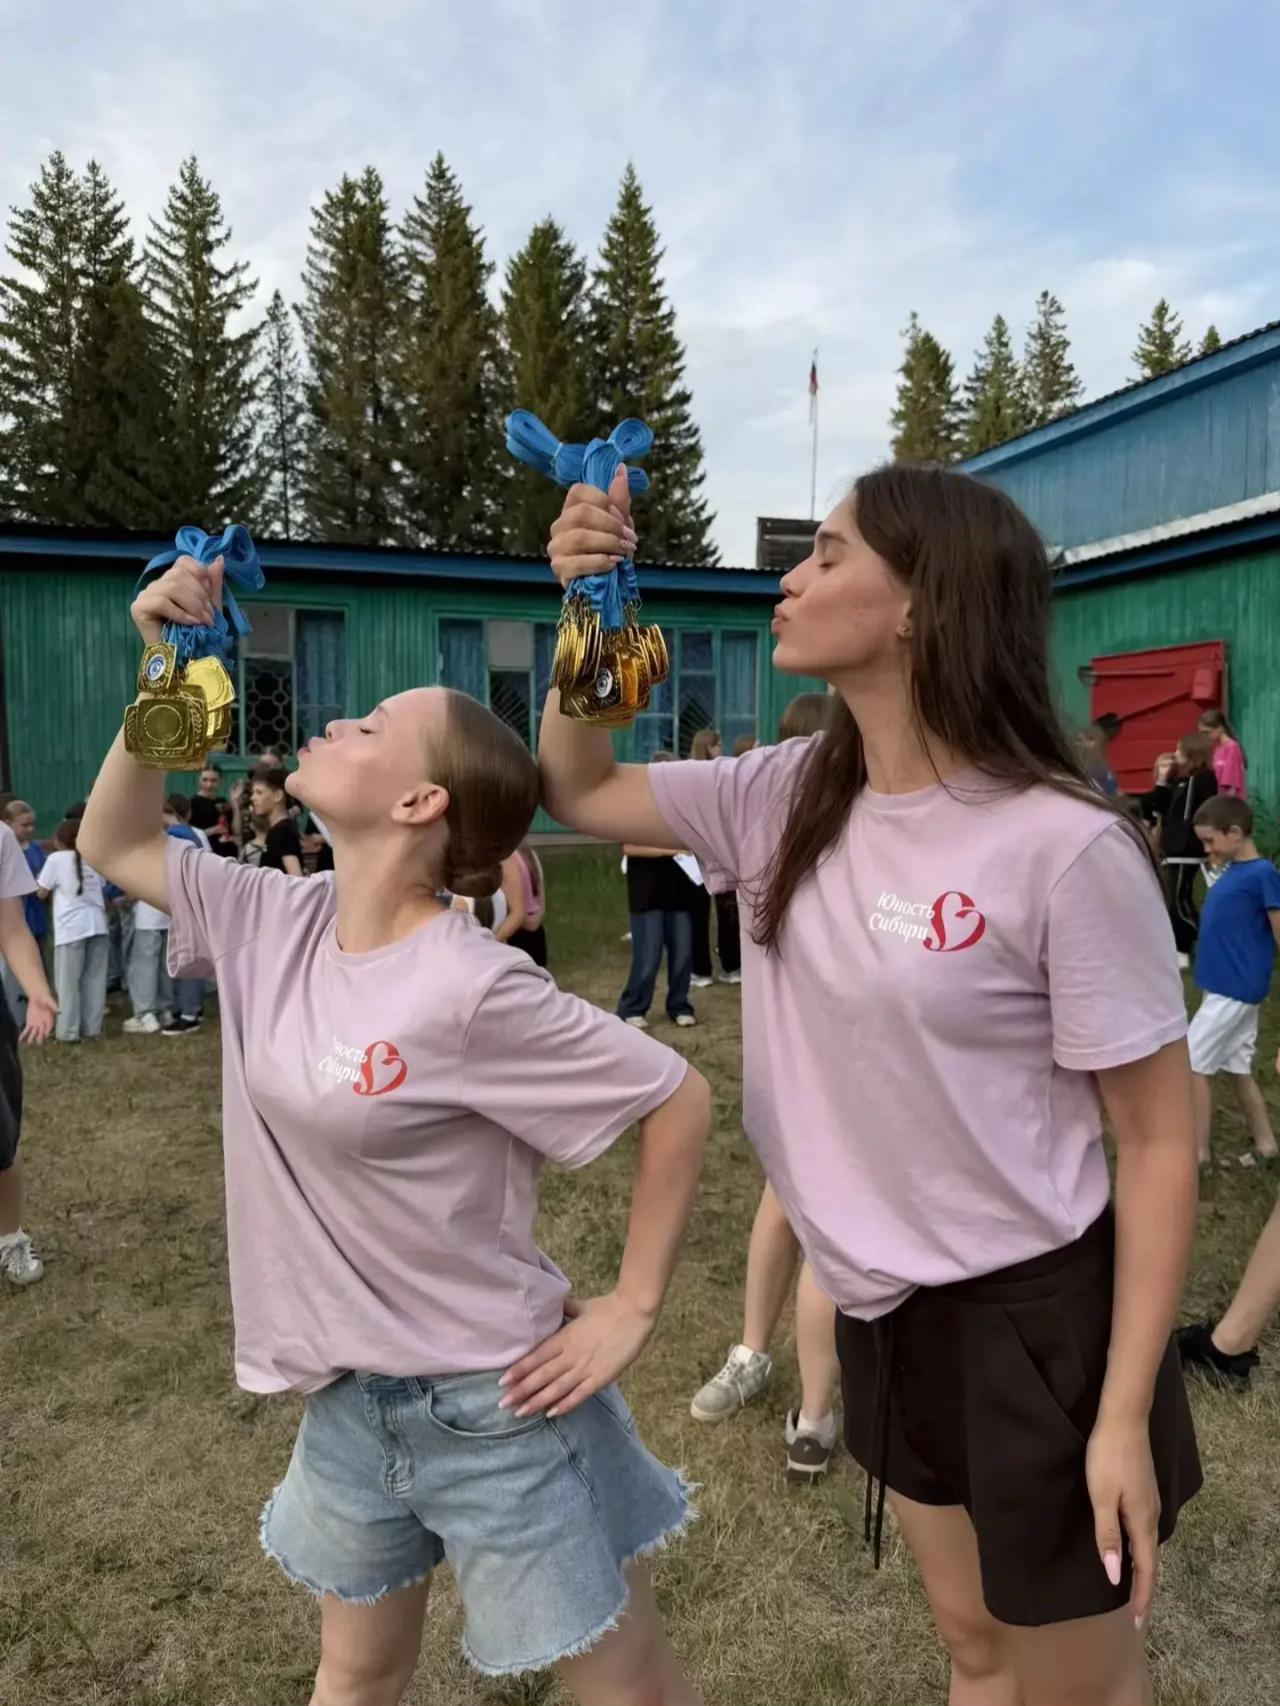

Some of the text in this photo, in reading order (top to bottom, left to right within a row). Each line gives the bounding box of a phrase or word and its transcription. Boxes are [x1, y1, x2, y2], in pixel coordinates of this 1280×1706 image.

[876, 892, 936, 919] Юность
[868, 912, 928, 943] Сибири
[332, 1035, 368, 1063] ность
[318, 1056, 361, 1084] Сири
